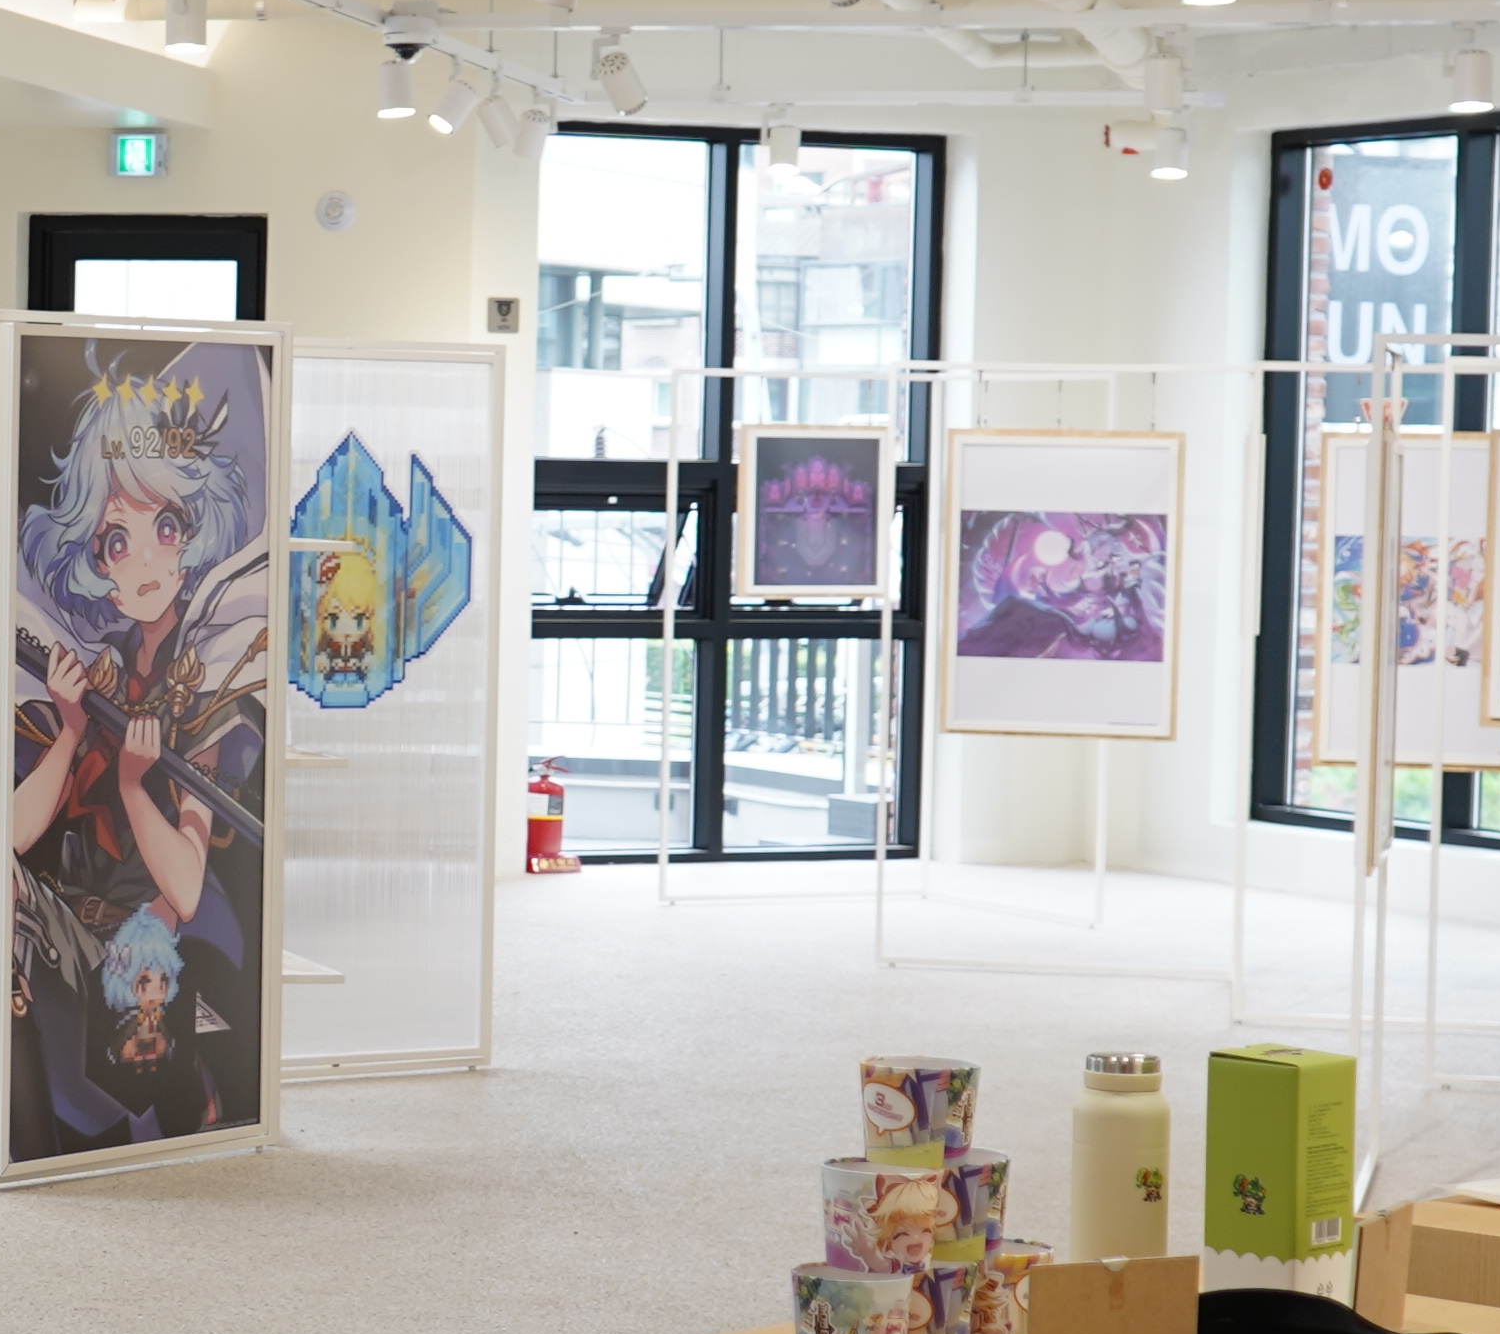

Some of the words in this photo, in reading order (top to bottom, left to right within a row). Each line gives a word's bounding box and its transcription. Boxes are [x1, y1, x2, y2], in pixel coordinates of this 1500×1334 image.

[1330, 203, 1430, 276] MO
[1328, 300, 1427, 364] UN
[100, 434, 126, 460] Lv.
[130, 425, 198, 460] 92/92
